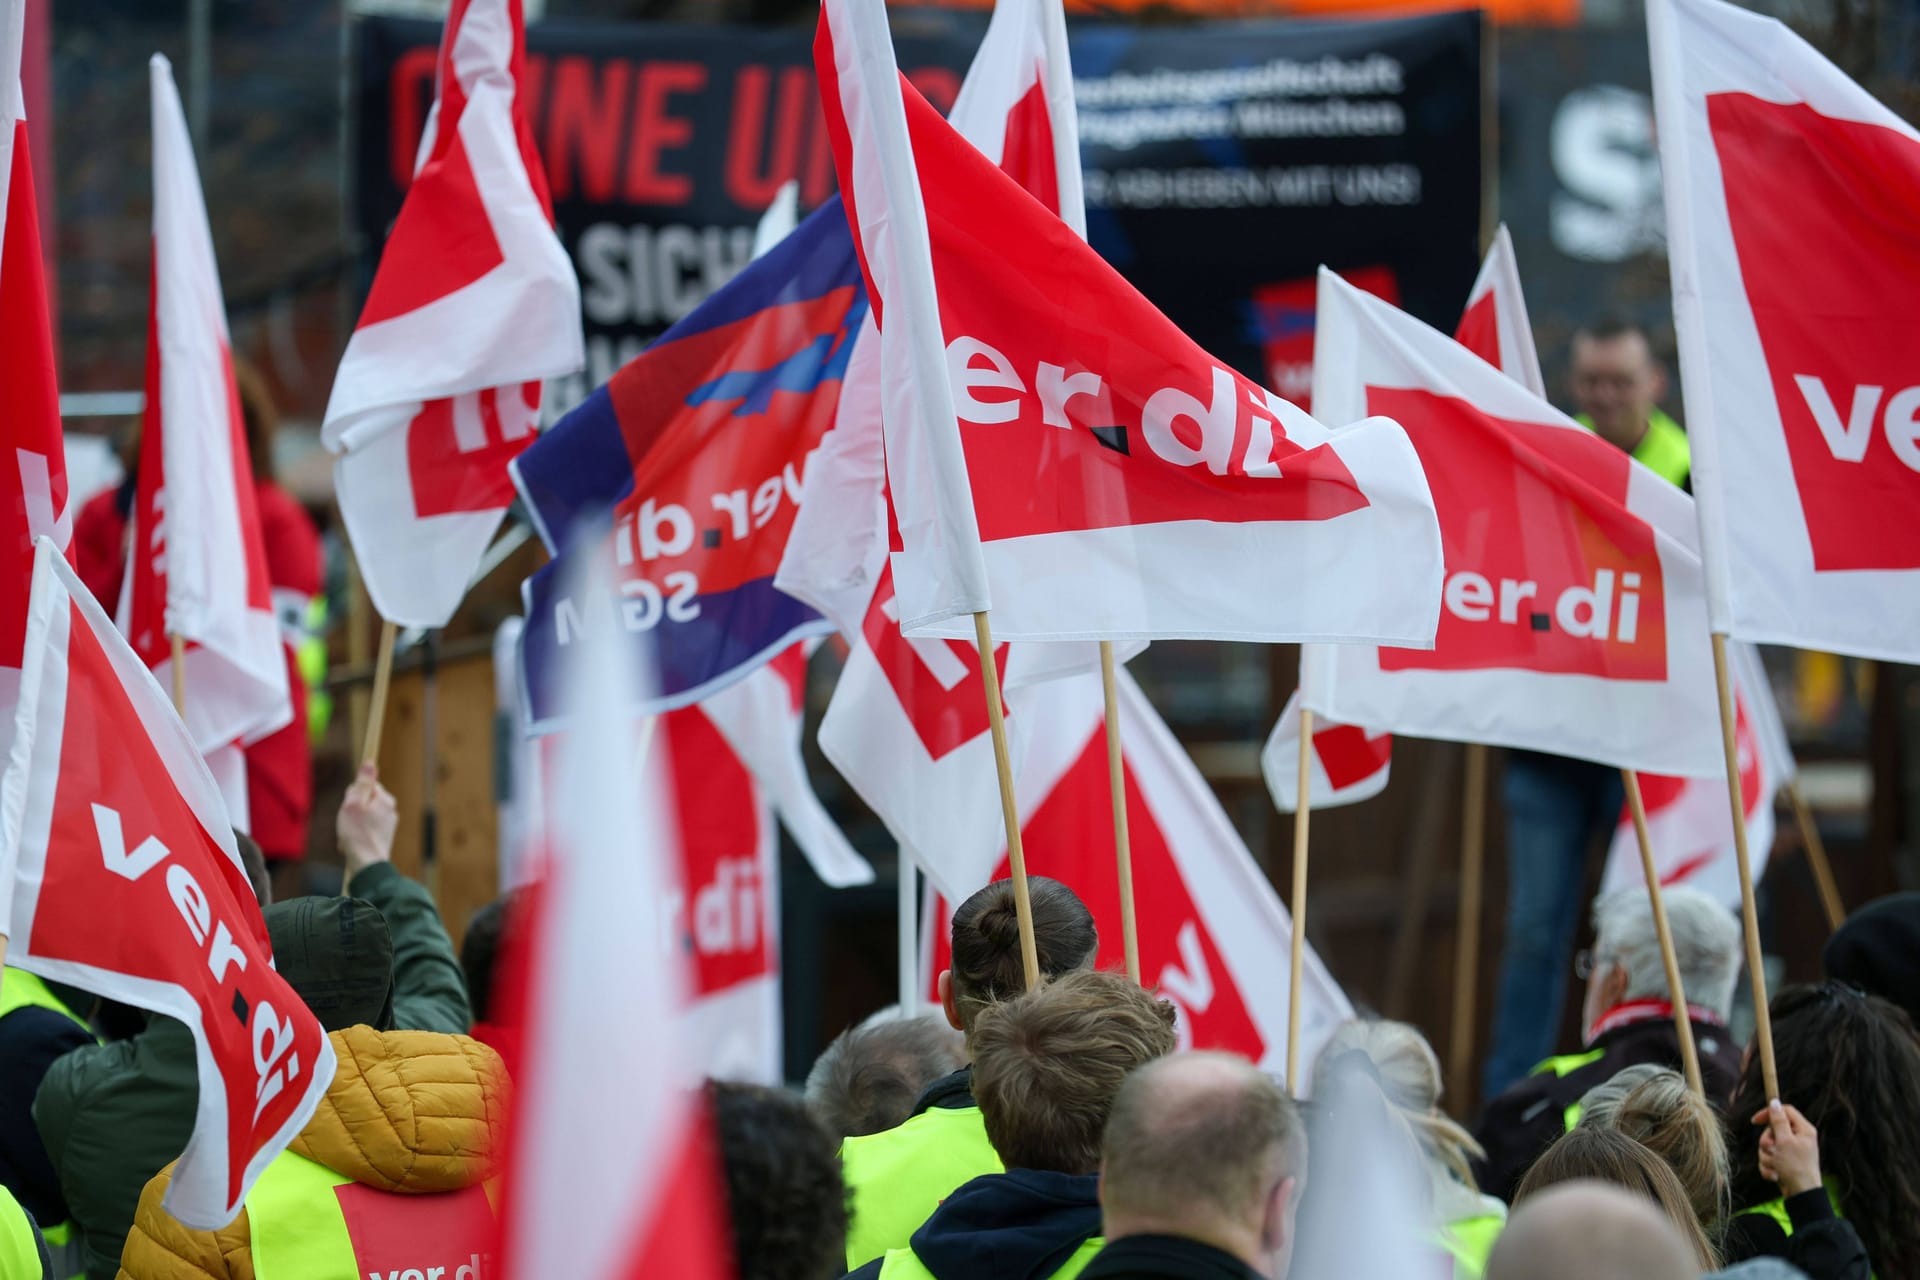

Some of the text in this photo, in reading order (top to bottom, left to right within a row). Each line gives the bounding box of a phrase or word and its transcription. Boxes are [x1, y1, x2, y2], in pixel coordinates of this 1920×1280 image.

[944, 335, 1284, 479] er.di
[1443, 568, 1642, 644] er.di
[90, 802, 300, 1130] ver.di
